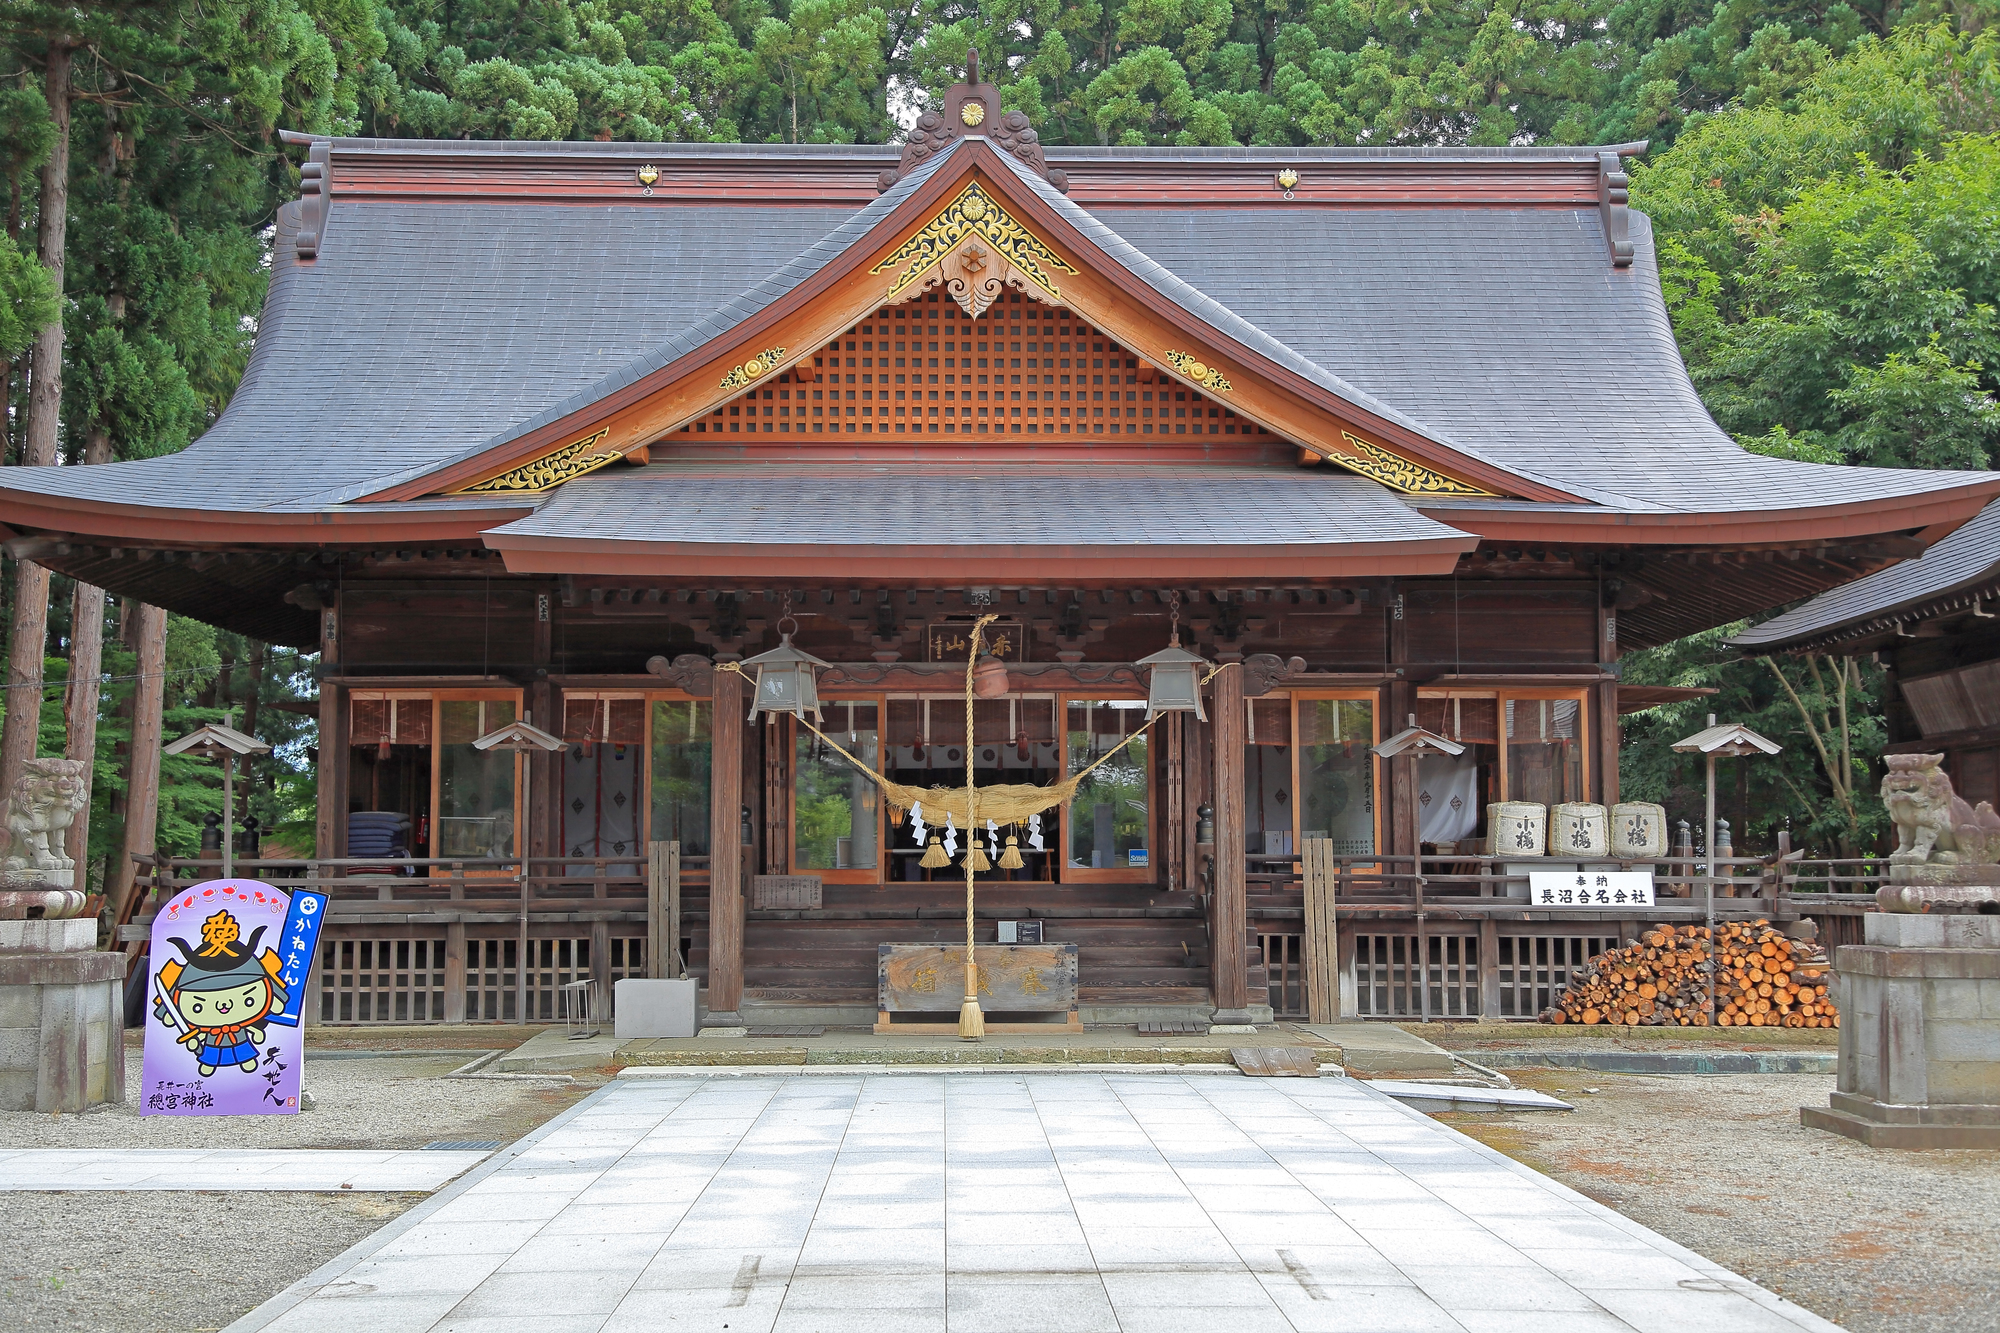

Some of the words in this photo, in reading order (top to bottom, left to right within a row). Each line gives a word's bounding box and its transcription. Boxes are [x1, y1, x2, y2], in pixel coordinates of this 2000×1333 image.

[1541, 889, 1648, 904] 長沼合名会社
[1575, 875, 1608, 887] 奉納
[199, 909, 240, 958] 愛
[284, 918, 312, 987] かねたん
